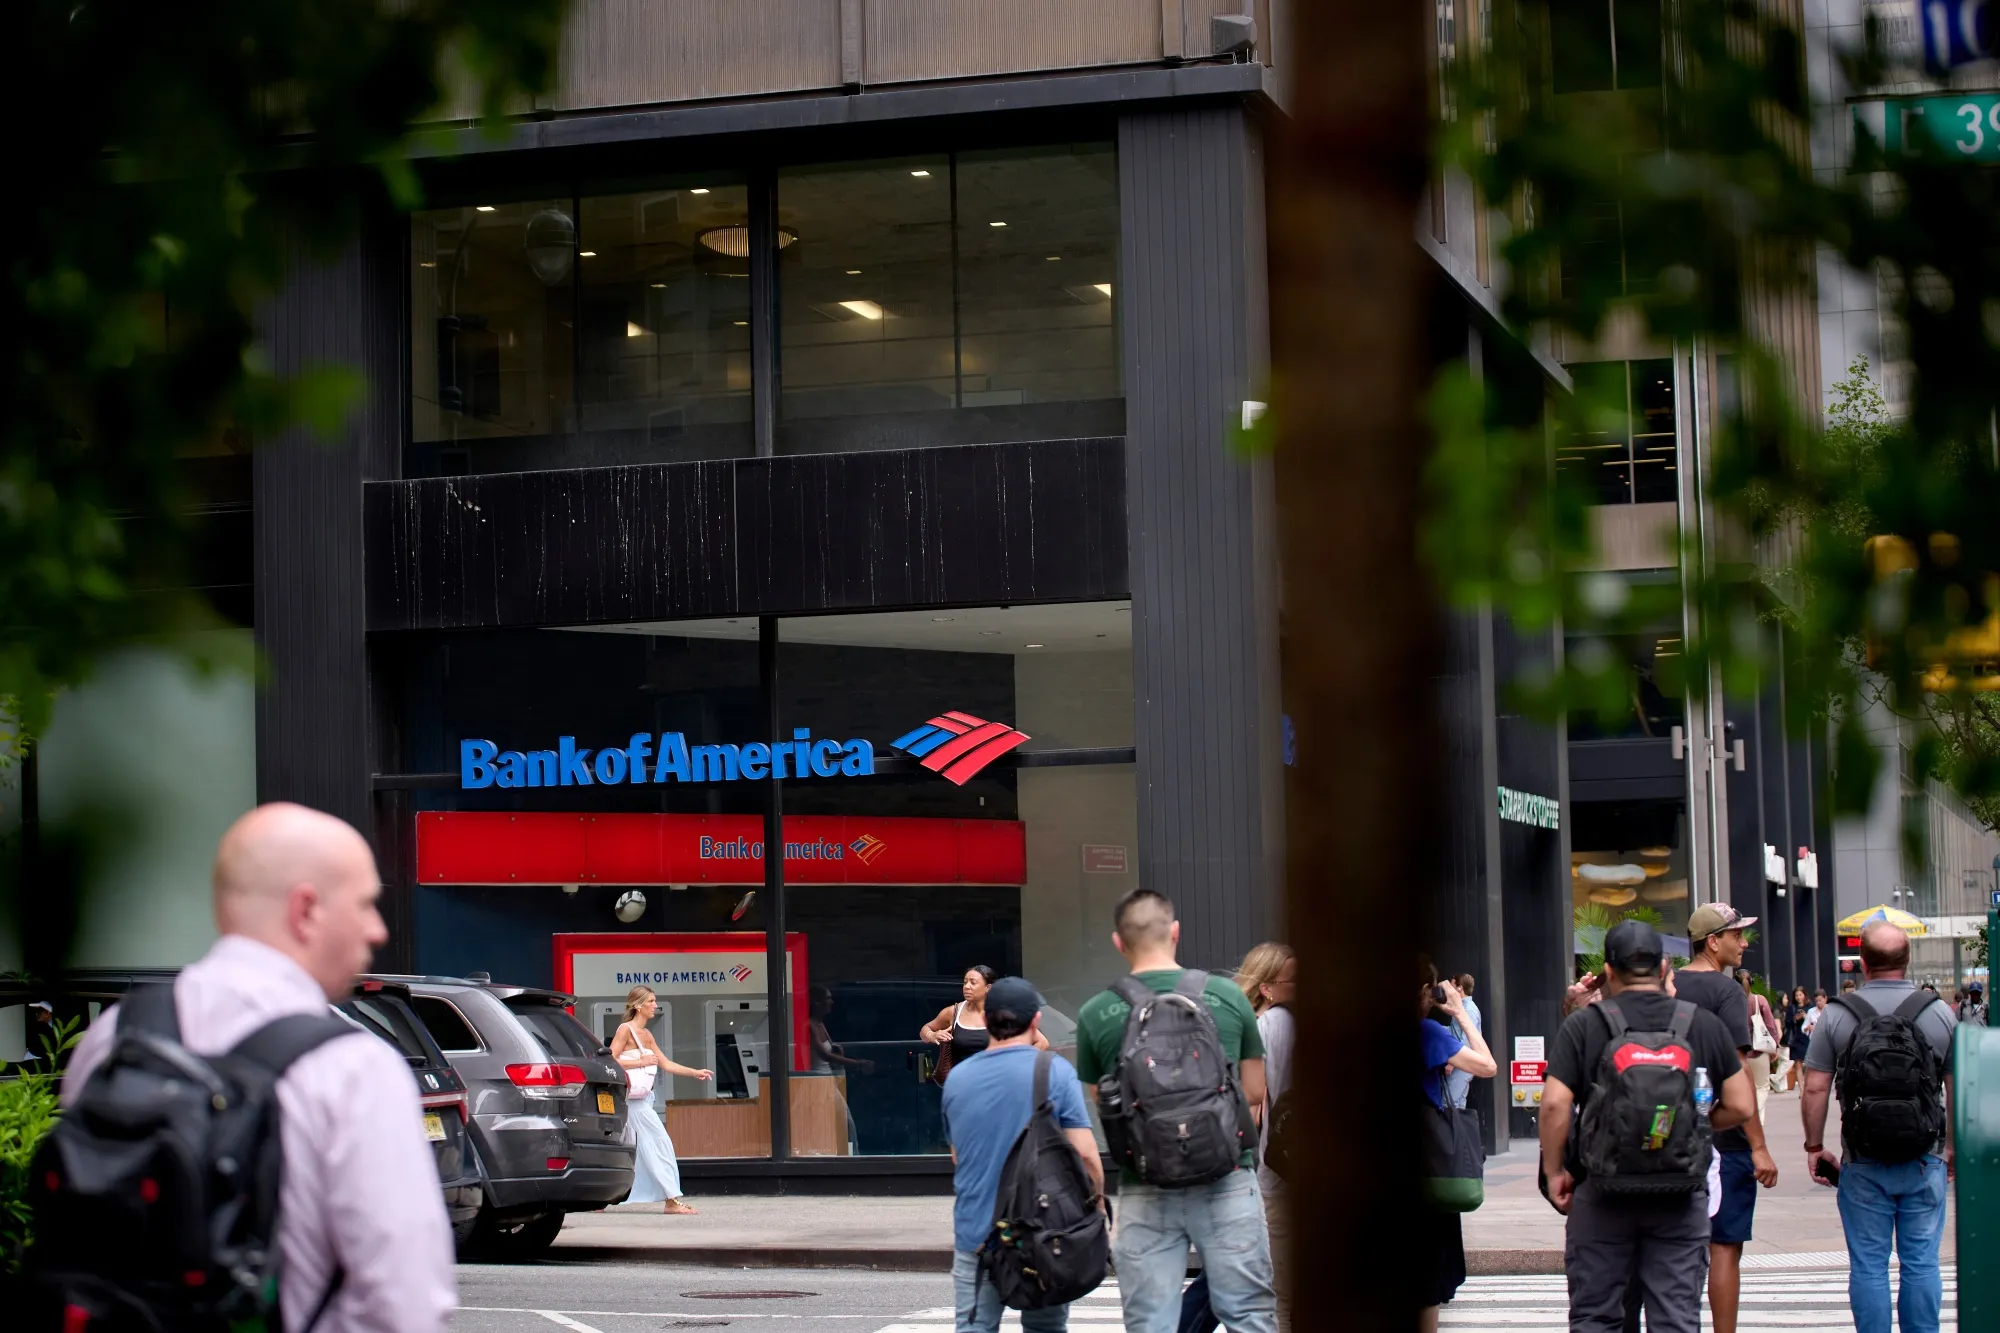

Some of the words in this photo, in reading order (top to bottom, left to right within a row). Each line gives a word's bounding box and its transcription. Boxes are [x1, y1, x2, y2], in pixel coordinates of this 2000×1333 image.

[461, 736, 595, 789] Bank
[595, 732, 652, 785] of
[654, 728, 875, 783] America
[1498, 786, 1538, 826] STARBUCKS
[1538, 796, 1559, 830] COFFEE
[700, 835, 749, 860] Bank
[751, 841, 764, 859] o
[783, 837, 844, 860] merica
[617, 972, 650, 984] BANK
[653, 972, 669, 983] OF
[672, 971, 726, 983] AMERICA
